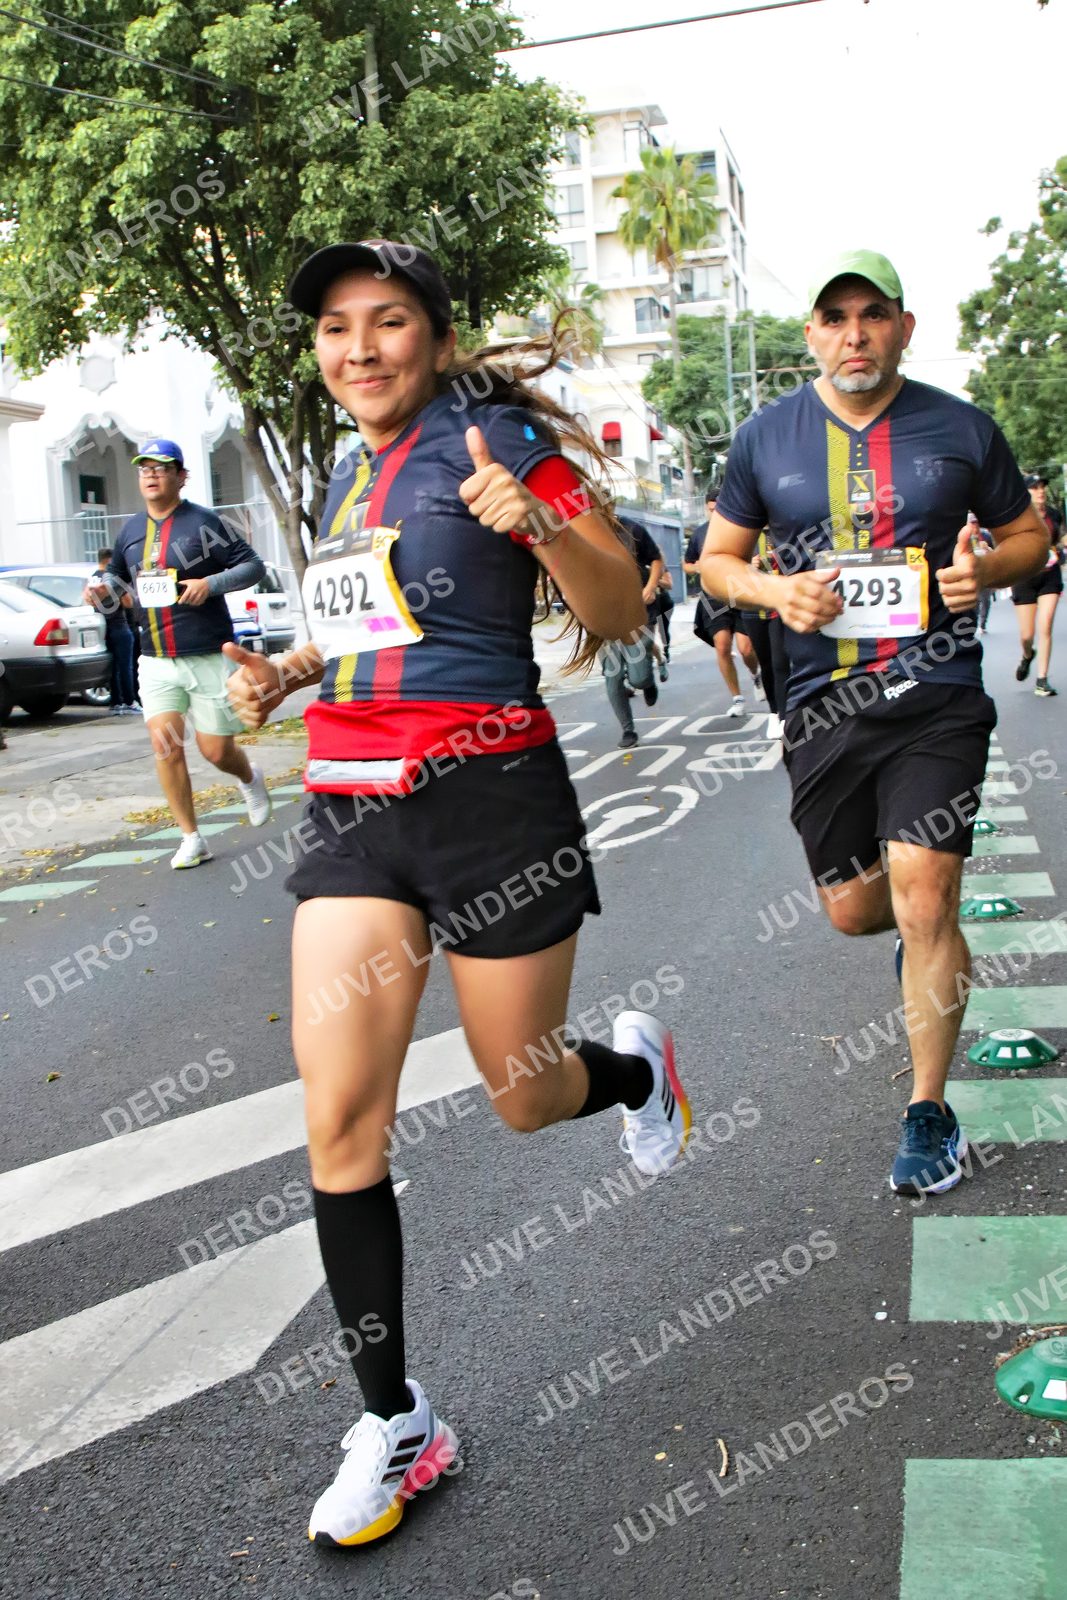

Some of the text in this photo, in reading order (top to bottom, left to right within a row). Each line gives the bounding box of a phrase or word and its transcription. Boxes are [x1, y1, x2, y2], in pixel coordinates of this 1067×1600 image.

[142, 582, 168, 594] 6678
[313, 571, 376, 618] 4292
[832, 577, 902, 608] 4293
